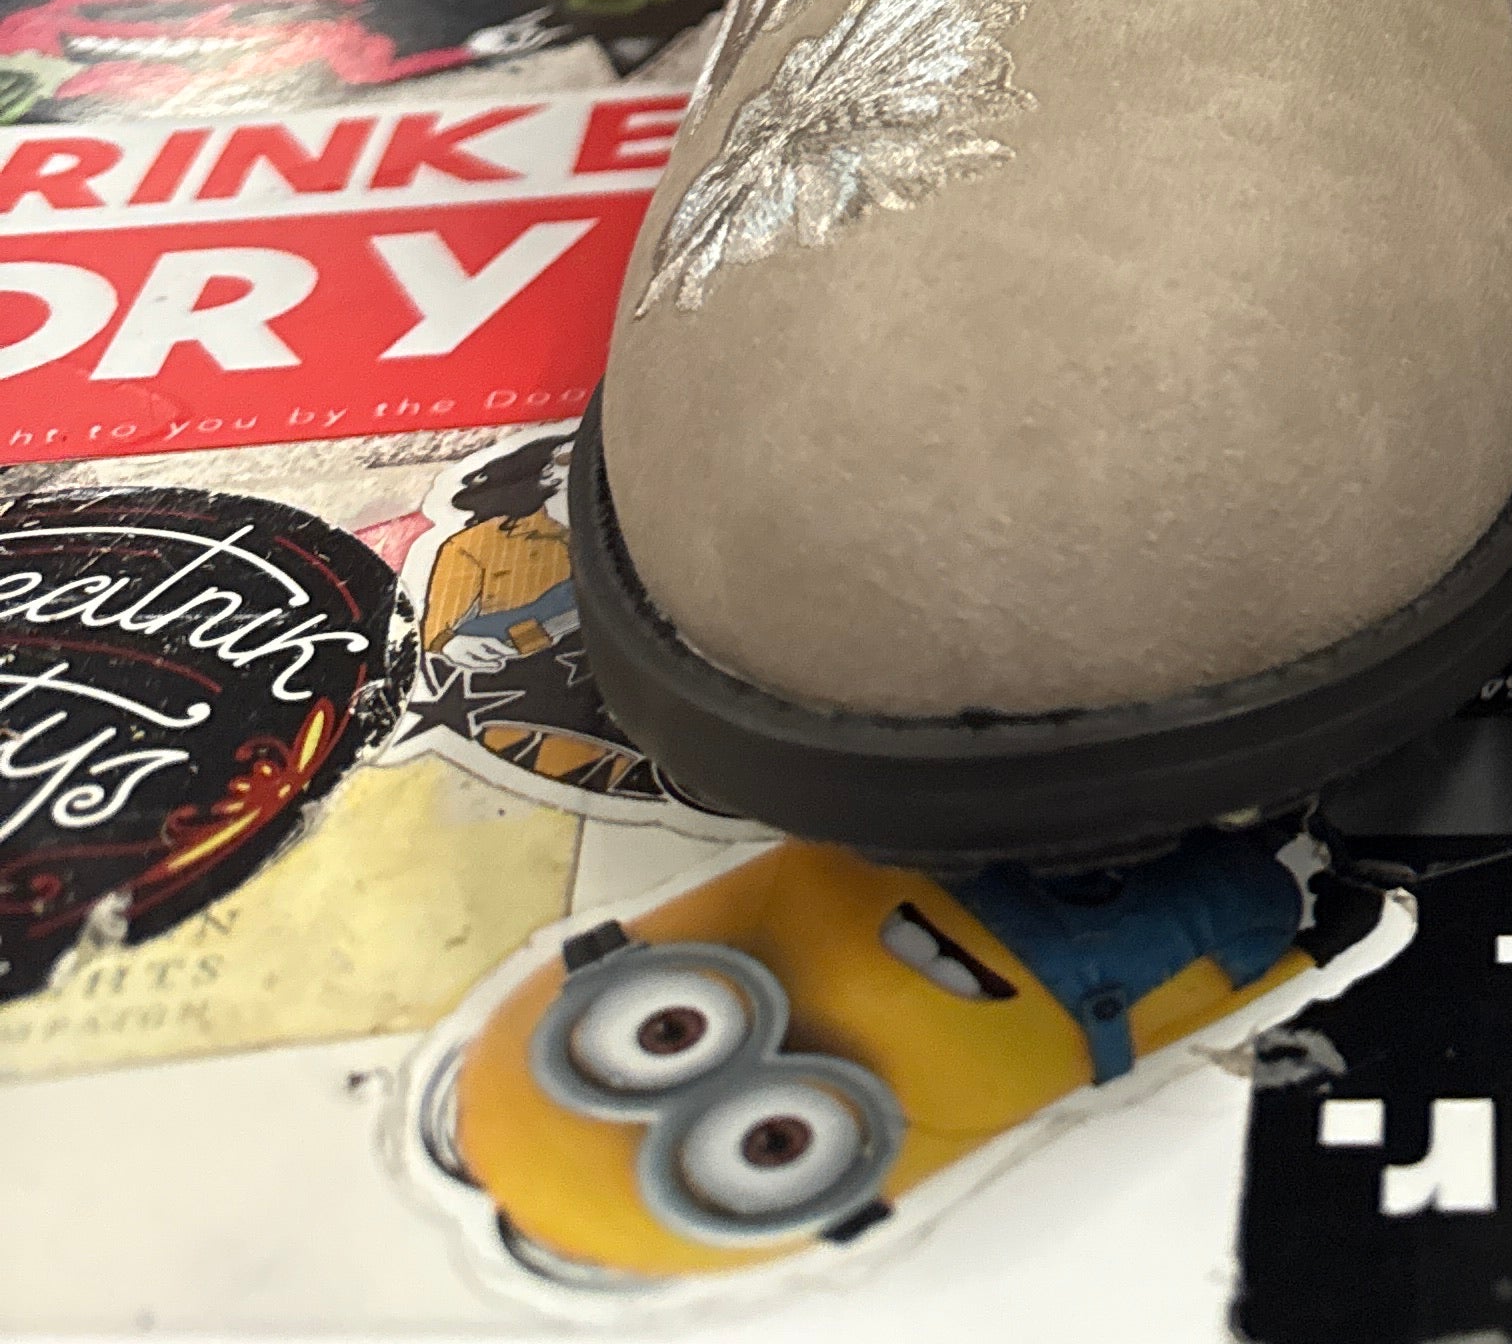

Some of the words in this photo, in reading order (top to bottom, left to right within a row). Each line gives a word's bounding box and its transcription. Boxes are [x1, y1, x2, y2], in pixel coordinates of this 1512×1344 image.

[89, 423, 137, 439] to
[164, 416, 258, 441] you
[289, 407, 347, 427] by
[375, 398, 456, 418] the
